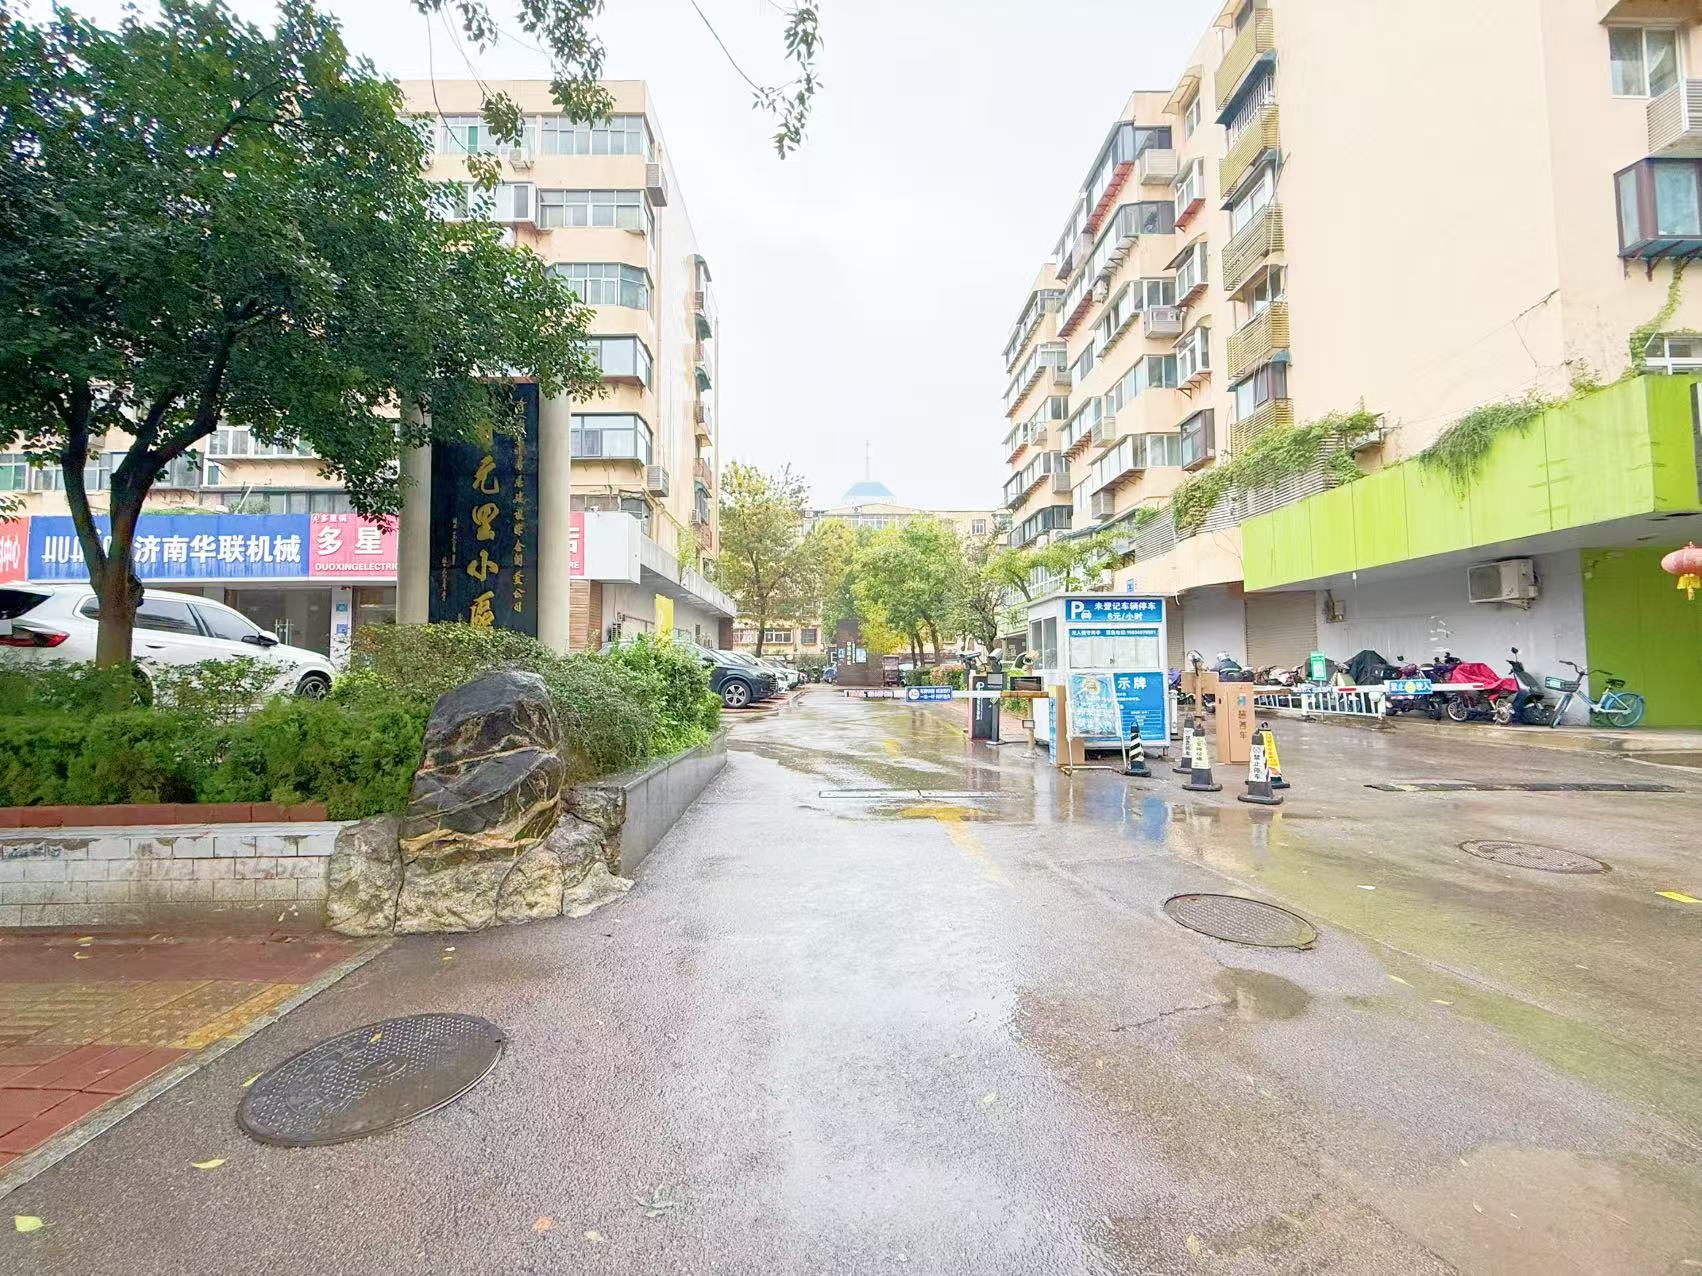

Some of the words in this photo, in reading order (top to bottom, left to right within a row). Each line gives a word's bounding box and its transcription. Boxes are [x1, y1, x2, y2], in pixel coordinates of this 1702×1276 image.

[134, 533, 302, 565] 济南华联机械
[316, 525, 384, 556] 多星
[1071, 601, 1085, 620] P
[1094, 602, 1156, 611] 未登记车辆停车
[1117, 676, 1147, 690] 示牌
[1253, 754, 1262, 780] 禁止停车
